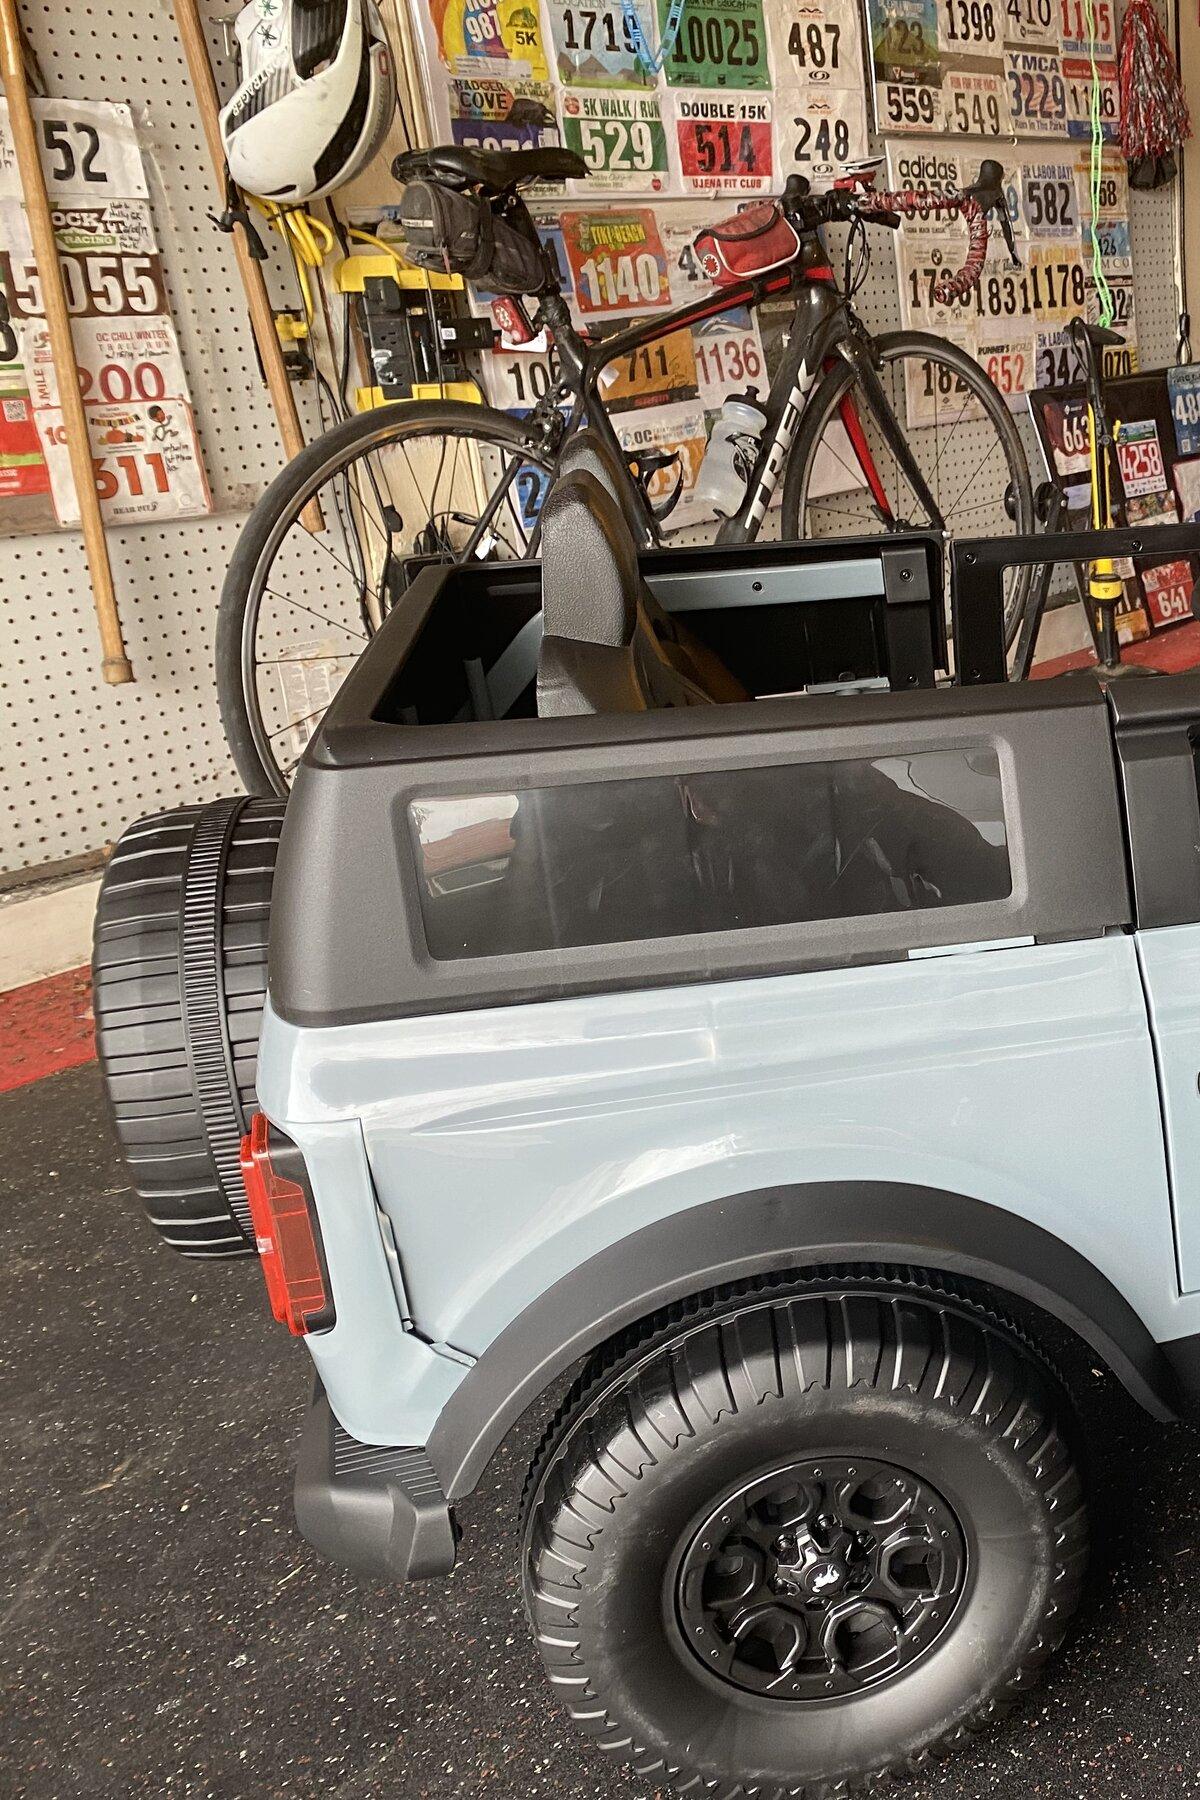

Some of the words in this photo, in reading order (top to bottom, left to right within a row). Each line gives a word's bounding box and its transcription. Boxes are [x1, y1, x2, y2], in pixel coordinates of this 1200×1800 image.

[515, 30, 538, 46] 5K
[946, 0, 996, 42] 1398
[787, 22, 841, 69] 487
[1008, 53, 1060, 73] YMCA
[460, 92, 508, 110] COVE
[583, 97, 599, 117] 5K
[600, 98, 632, 119] WALK
[640, 99, 661, 118] RUN
[680, 101, 735, 119] DOUBLE
[740, 104, 767, 120] 15K
[886, 85, 934, 124] 559
[954, 92, 1001, 136] 549
[1007, 70, 1067, 119] 3229
[42, 119, 108, 183] 52
[578, 120, 655, 172] 529
[694, 124, 757, 173] 514
[793, 117, 850, 162] 248
[692, 178, 721, 189] UJENA
[724, 178, 737, 188] FIT
[740, 179, 762, 189] CLUB
[898, 156, 958, 181] adidas
[1033, 164, 1057, 180] LABOR
[50, 210, 99, 228] OCK
[1027, 181, 1074, 226] 582
[62, 235, 114, 246] RACING
[579, 253, 661, 306] 1140
[1085, 258, 1129, 269] PMCO
[908, 267, 972, 308] 17
[974, 277, 1032, 317] 1831
[1030, 263, 1085, 309] 1178
[110, 331, 133, 342] CHILI
[135, 328, 168, 341] WINTER
[1048, 331, 1072, 348] LABO
[622, 345, 668, 382] 711
[694, 337, 762, 385] 1136
[987, 354, 1025, 395] 652
[77, 362, 166, 403] 200
[745, 357, 815, 530] TREK
[1062, 414, 1092, 452] 663
[95, 452, 170, 500] 611
[1120, 442, 1163, 482] 4258
[1157, 585, 1189, 618] 641
